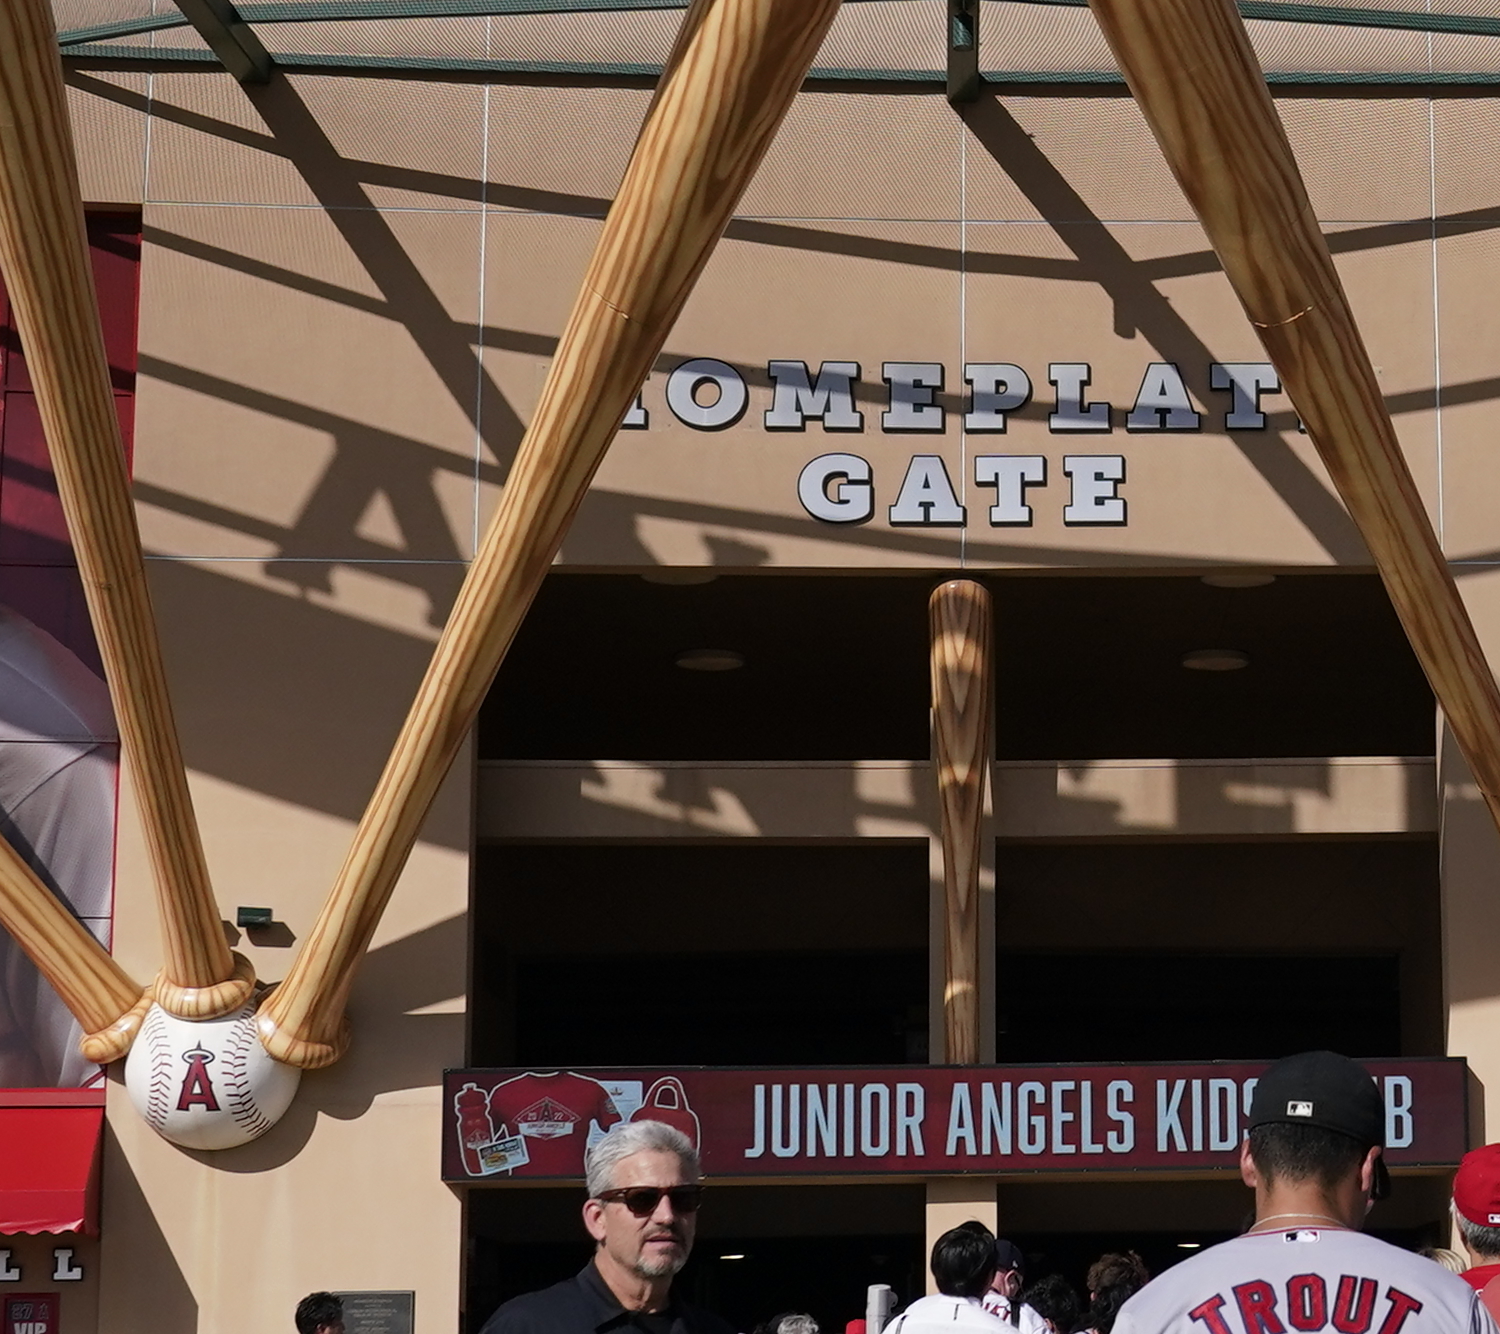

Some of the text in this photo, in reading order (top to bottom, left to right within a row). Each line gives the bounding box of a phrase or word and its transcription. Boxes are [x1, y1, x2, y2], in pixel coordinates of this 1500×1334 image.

[622, 358, 1285, 435] OMEPLAT
[796, 451, 1128, 528] GATE
[175, 1039, 222, 1112] A
[744, 1082, 926, 1160] JUNIOR
[946, 1078, 1136, 1157] ANGELS
